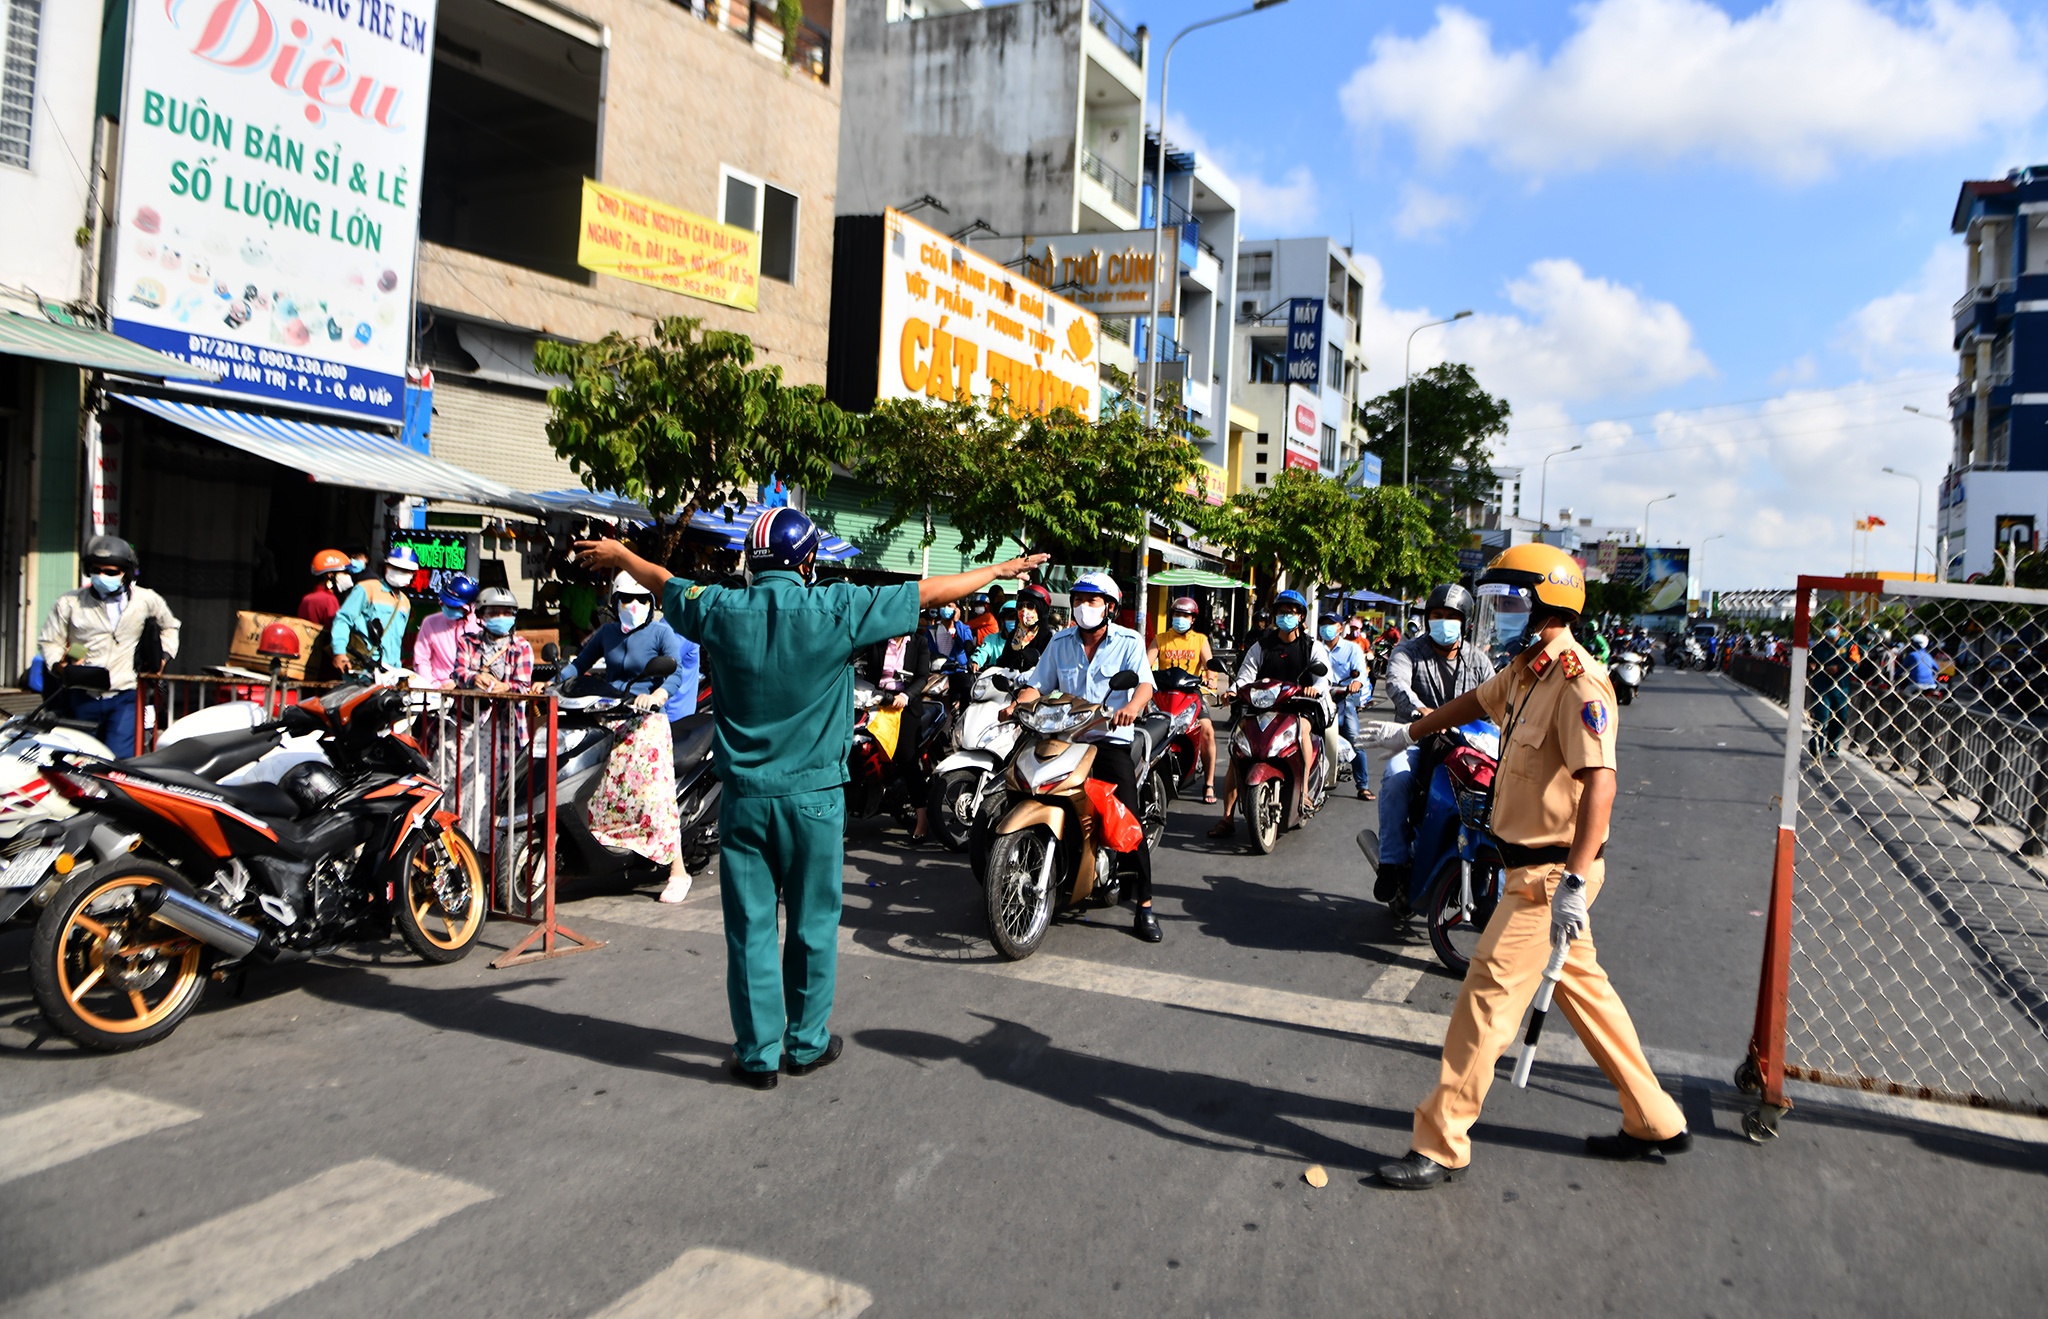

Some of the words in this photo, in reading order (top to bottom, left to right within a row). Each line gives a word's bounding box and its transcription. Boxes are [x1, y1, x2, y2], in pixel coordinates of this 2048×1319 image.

[400, 10, 427, 54] EM
[164, 0, 404, 128] Diệu
[143, 88, 233, 151] BUÔN
[245, 123, 303, 174] BÁN
[313, 142, 342, 187] SỈ
[349, 165, 367, 195] &
[378, 167, 408, 208] LẺ
[170, 157, 215, 201] SỐ
[225, 177, 320, 235] LƯỢNG
[331, 208, 382, 252] LỚN
[597, 193, 618, 217] CHO
[622, 202, 648, 228] THUÊ
[652, 212, 690, 240] NGUYÊN
[714, 230, 728, 251] DÀI
[731, 238, 749, 258] HẠN
[587, 222, 622, 250] NGANG
[645, 237, 663, 261] DÀI
[691, 249, 704, 272] NỞ
[706, 258, 726, 281] HẬU
[729, 265, 754, 288] 10.5m
[920, 242, 948, 273] CỬA
[951, 259, 986, 292] HÀNG
[988, 276, 1015, 308] PHẬT
[1019, 293, 1044, 321] GIÁO
[1028, 245, 1055, 287] ĐỒ
[1062, 249, 1102, 286] THỜ
[684, 278, 701, 293] 362
[704, 284, 727, 300] 9192
[906, 271, 930, 301] VẬT
[935, 284, 973, 319] PHẨM
[987, 308, 1024, 342] PHONG
[1294, 302, 1318, 324] MÁY
[188, 335, 256, 363] ĐT/ZALO:
[900, 316, 979, 406] CÁT
[986, 351, 1090, 422] TƯỜNG
[1288, 357, 1318, 380] NƯỚC
[1293, 332, 1315, 354] LỌC
[190, 354, 229, 378] PHAN
[232, 360, 261, 383] VĂN
[264, 368, 287, 390] TRỊ
[298, 377, 311, 393] P.
[333, 383, 346, 401] Q.
[349, 383, 367, 402] GÒ
[369, 386, 393, 407] VẤP
[445, 539, 466, 570] YẾN
